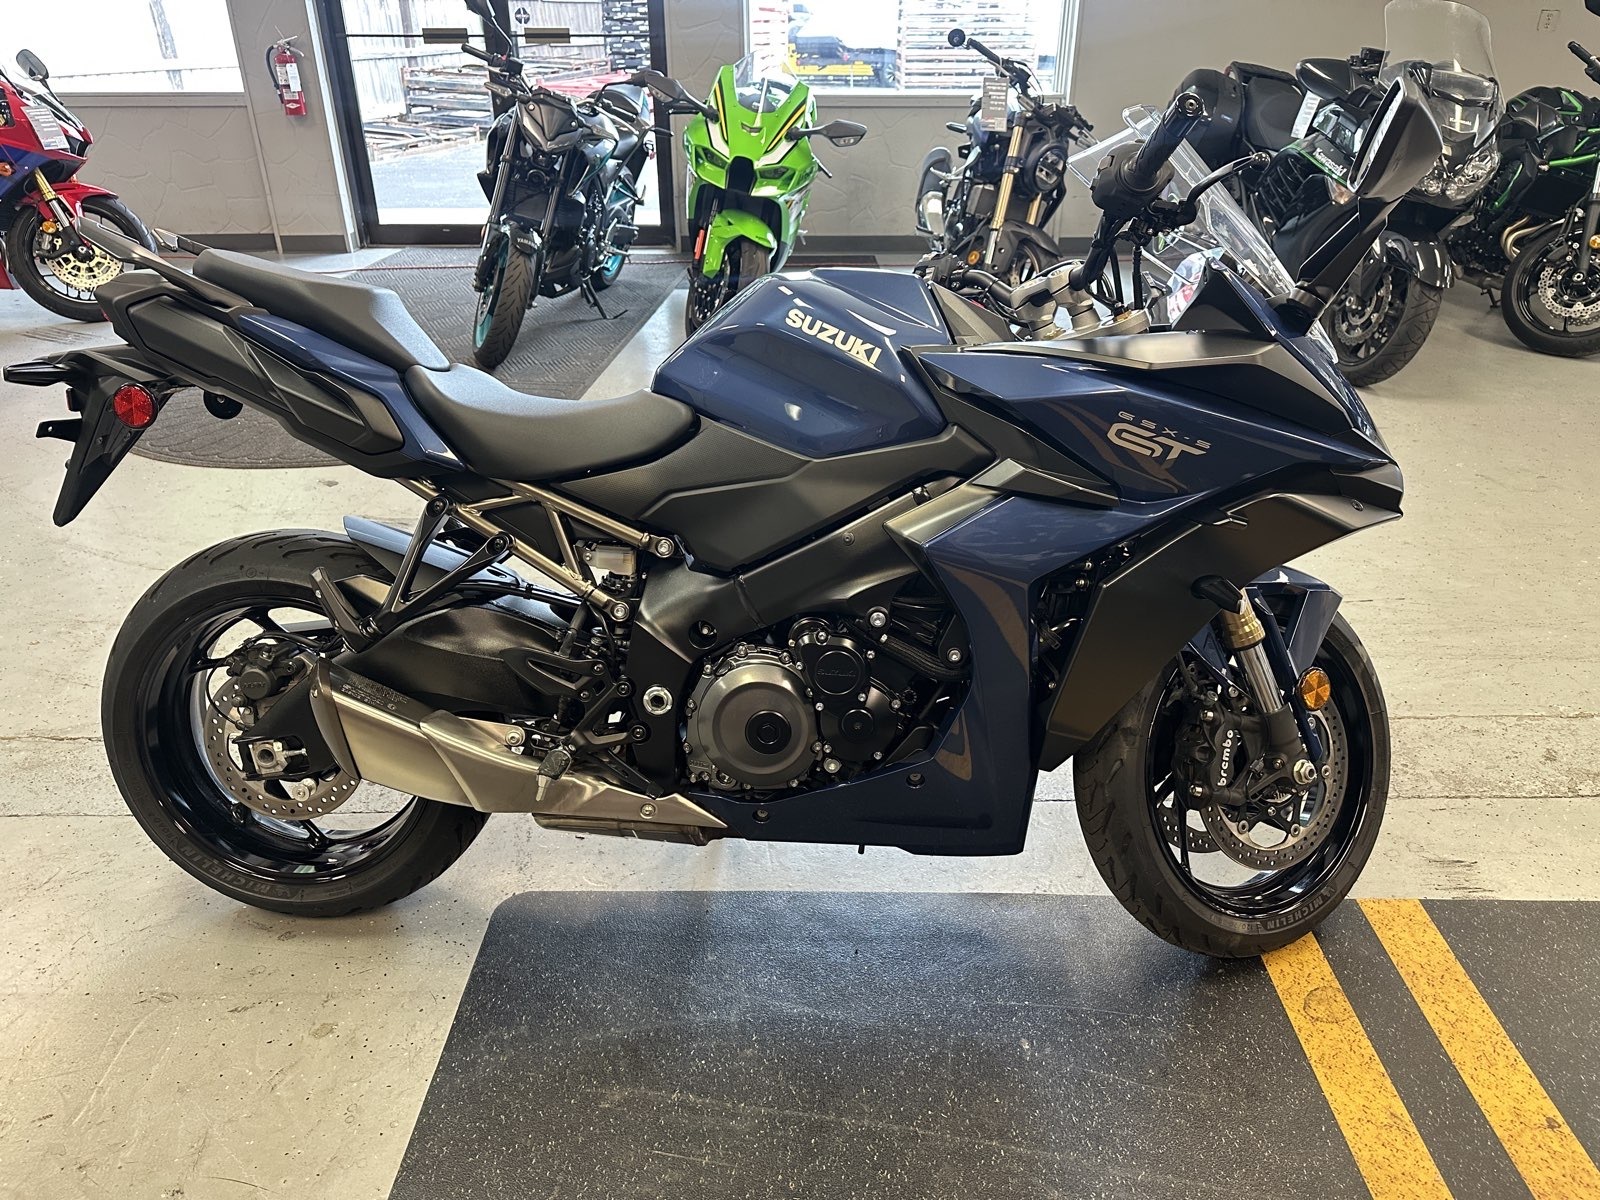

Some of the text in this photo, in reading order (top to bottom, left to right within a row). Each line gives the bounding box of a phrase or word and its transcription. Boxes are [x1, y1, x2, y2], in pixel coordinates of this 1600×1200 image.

[1312, 147, 1347, 176] Kawasaki
[785, 308, 882, 365] SUZUKI
[1107, 423, 1207, 460] GT
[1118, 411, 1211, 449] GSX-S
[1217, 729, 1234, 786] brembo
[182, 842, 271, 895] MICHELIN
[1266, 896, 1325, 930] MICHELIN
